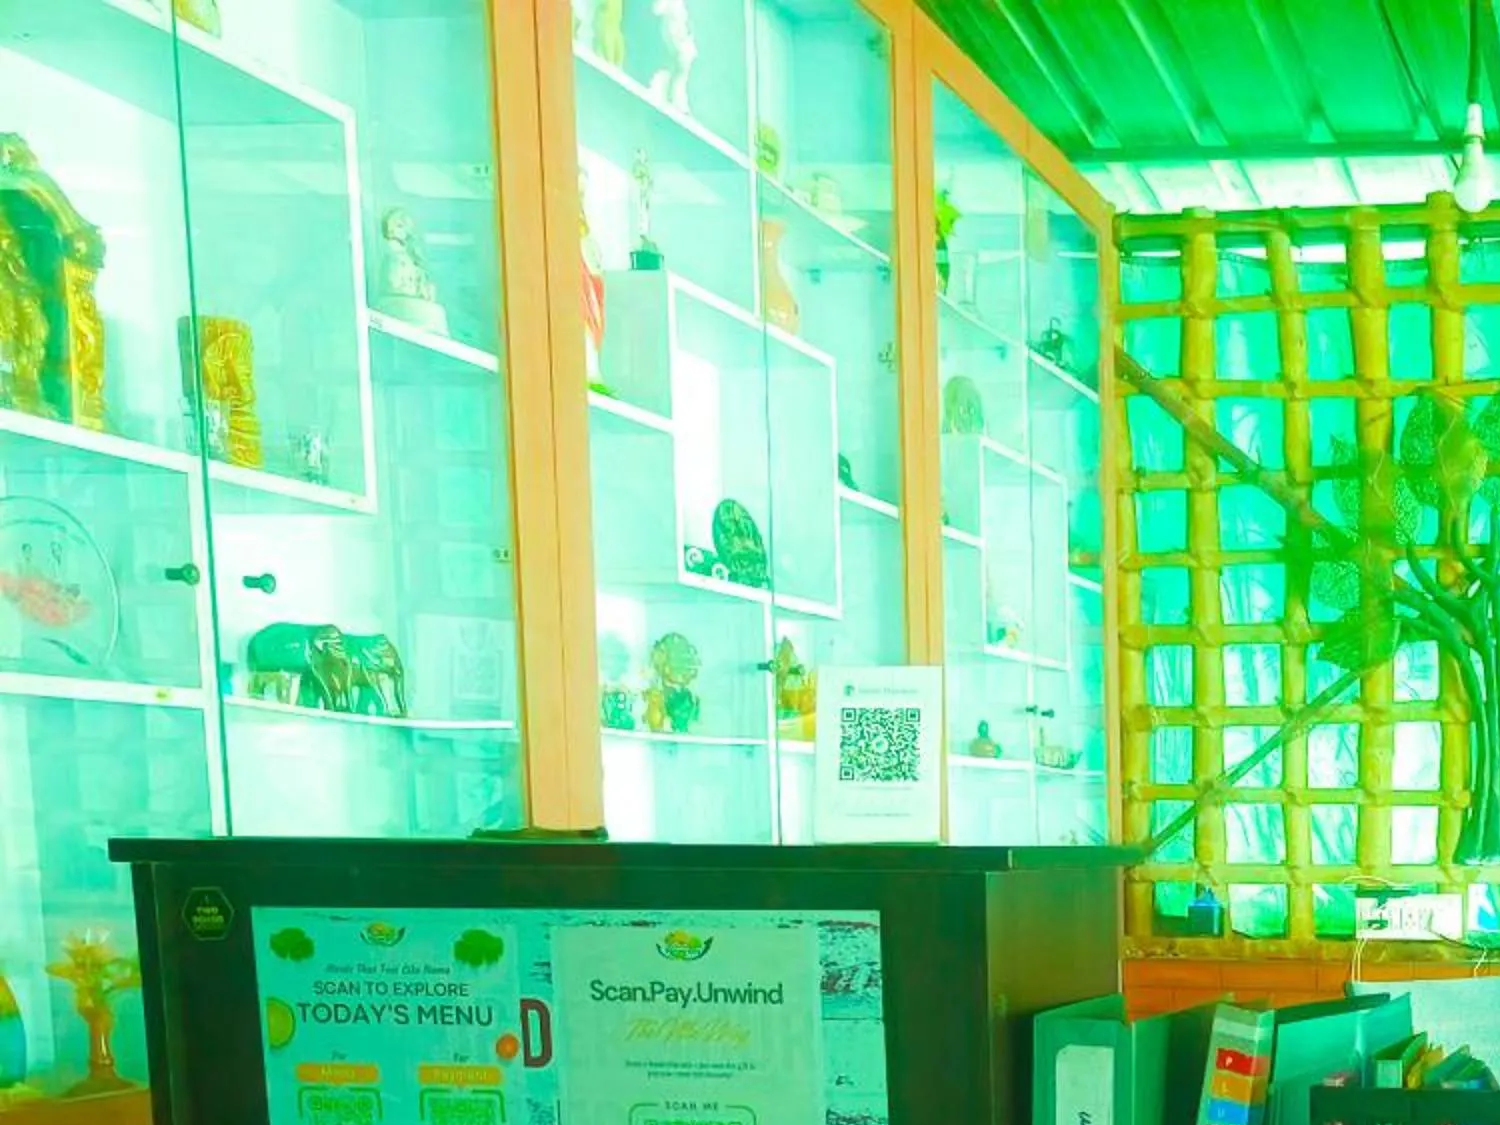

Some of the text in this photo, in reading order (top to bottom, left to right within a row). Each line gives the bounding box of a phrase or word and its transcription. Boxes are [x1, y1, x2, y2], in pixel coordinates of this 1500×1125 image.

[313, 981, 470, 997] SCAN TO EXPLORE
[589, 979, 784, 1009] Scan.Pay.Unwind
[297, 1002, 494, 1027] TODAY'S MENU
[665, 1101, 719, 1111] SCAN ME
